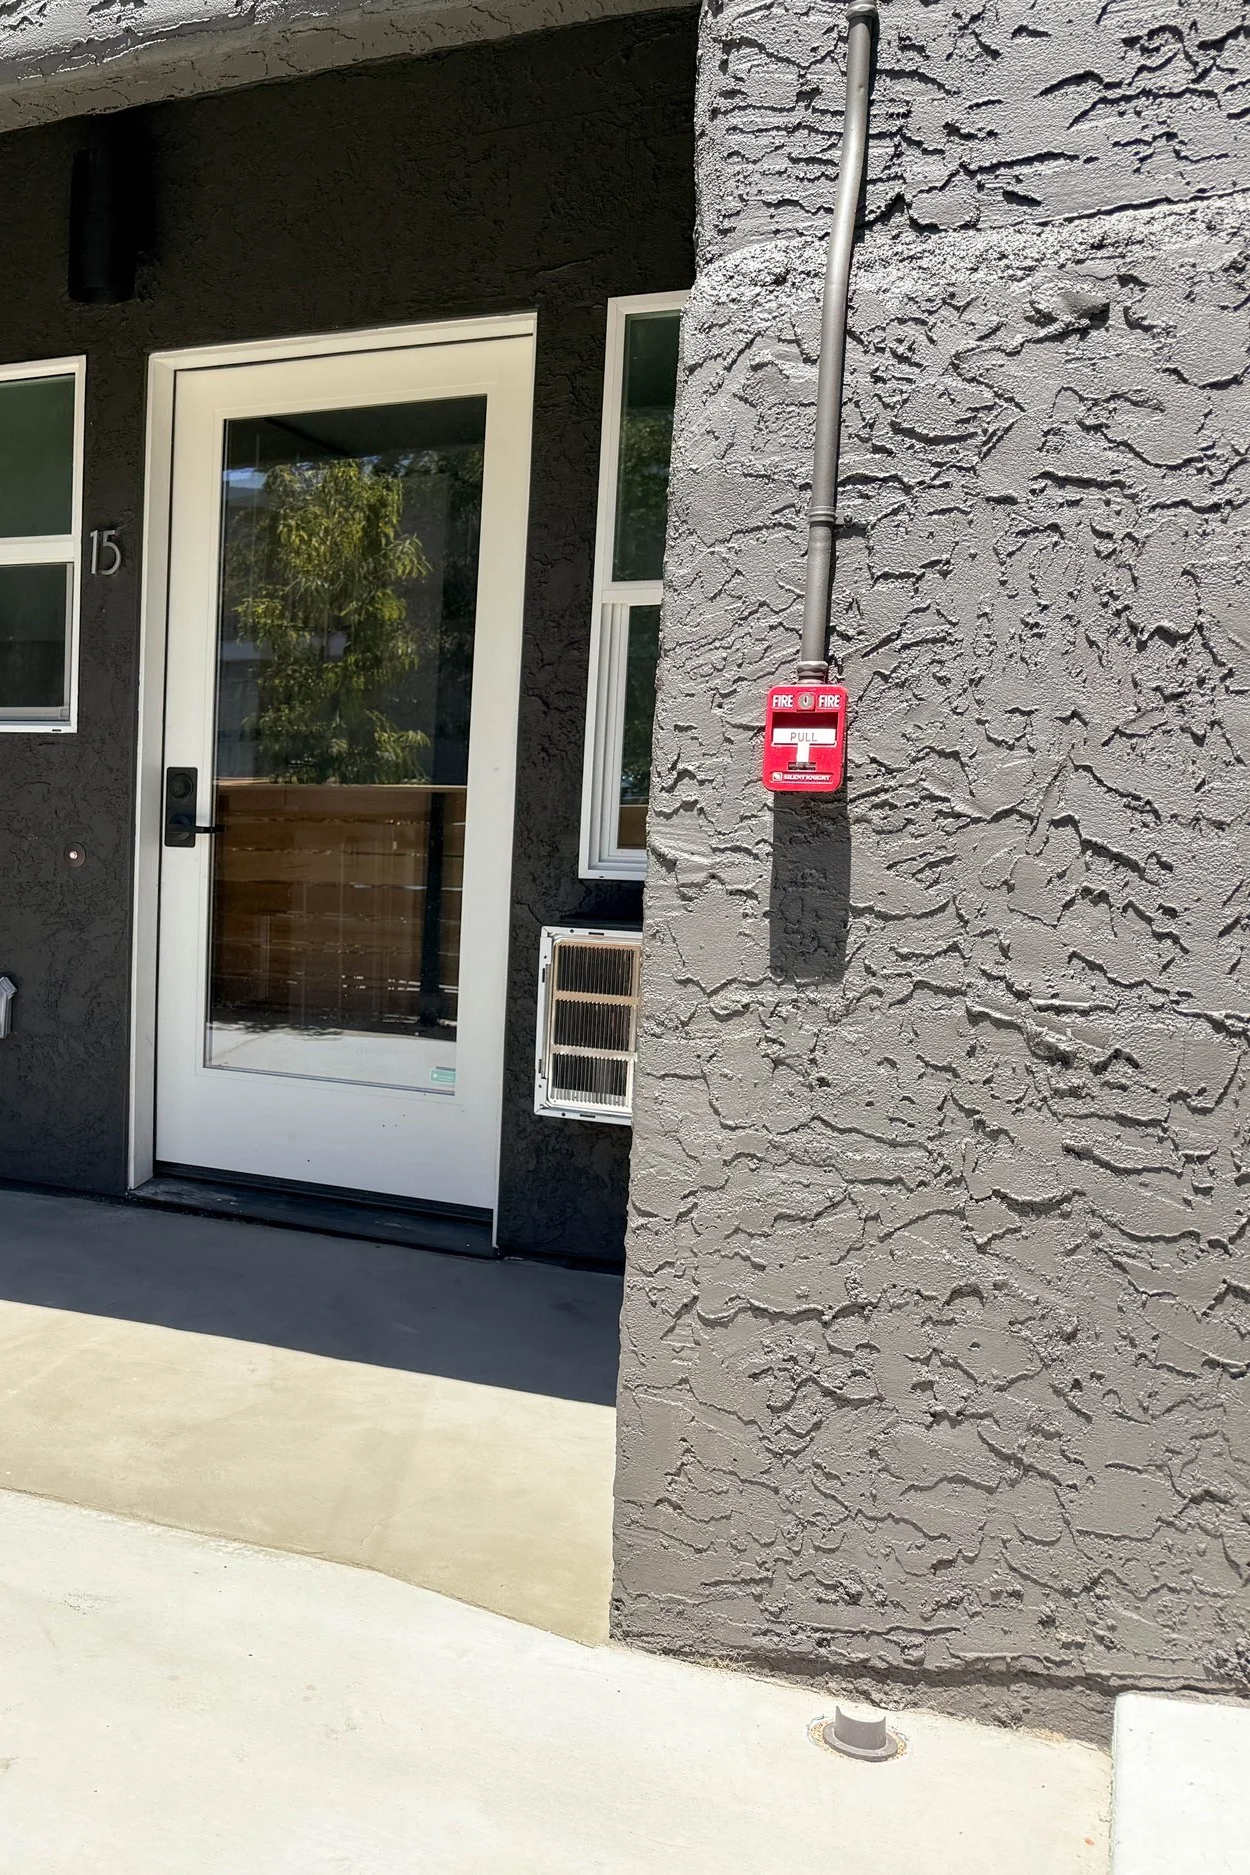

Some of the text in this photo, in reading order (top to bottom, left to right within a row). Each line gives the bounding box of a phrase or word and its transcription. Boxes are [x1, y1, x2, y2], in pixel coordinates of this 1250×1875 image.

[90, 529, 121, 575] 15
[772, 694, 841, 708] FIRE FIRE
[790, 732, 818, 742] PULL
